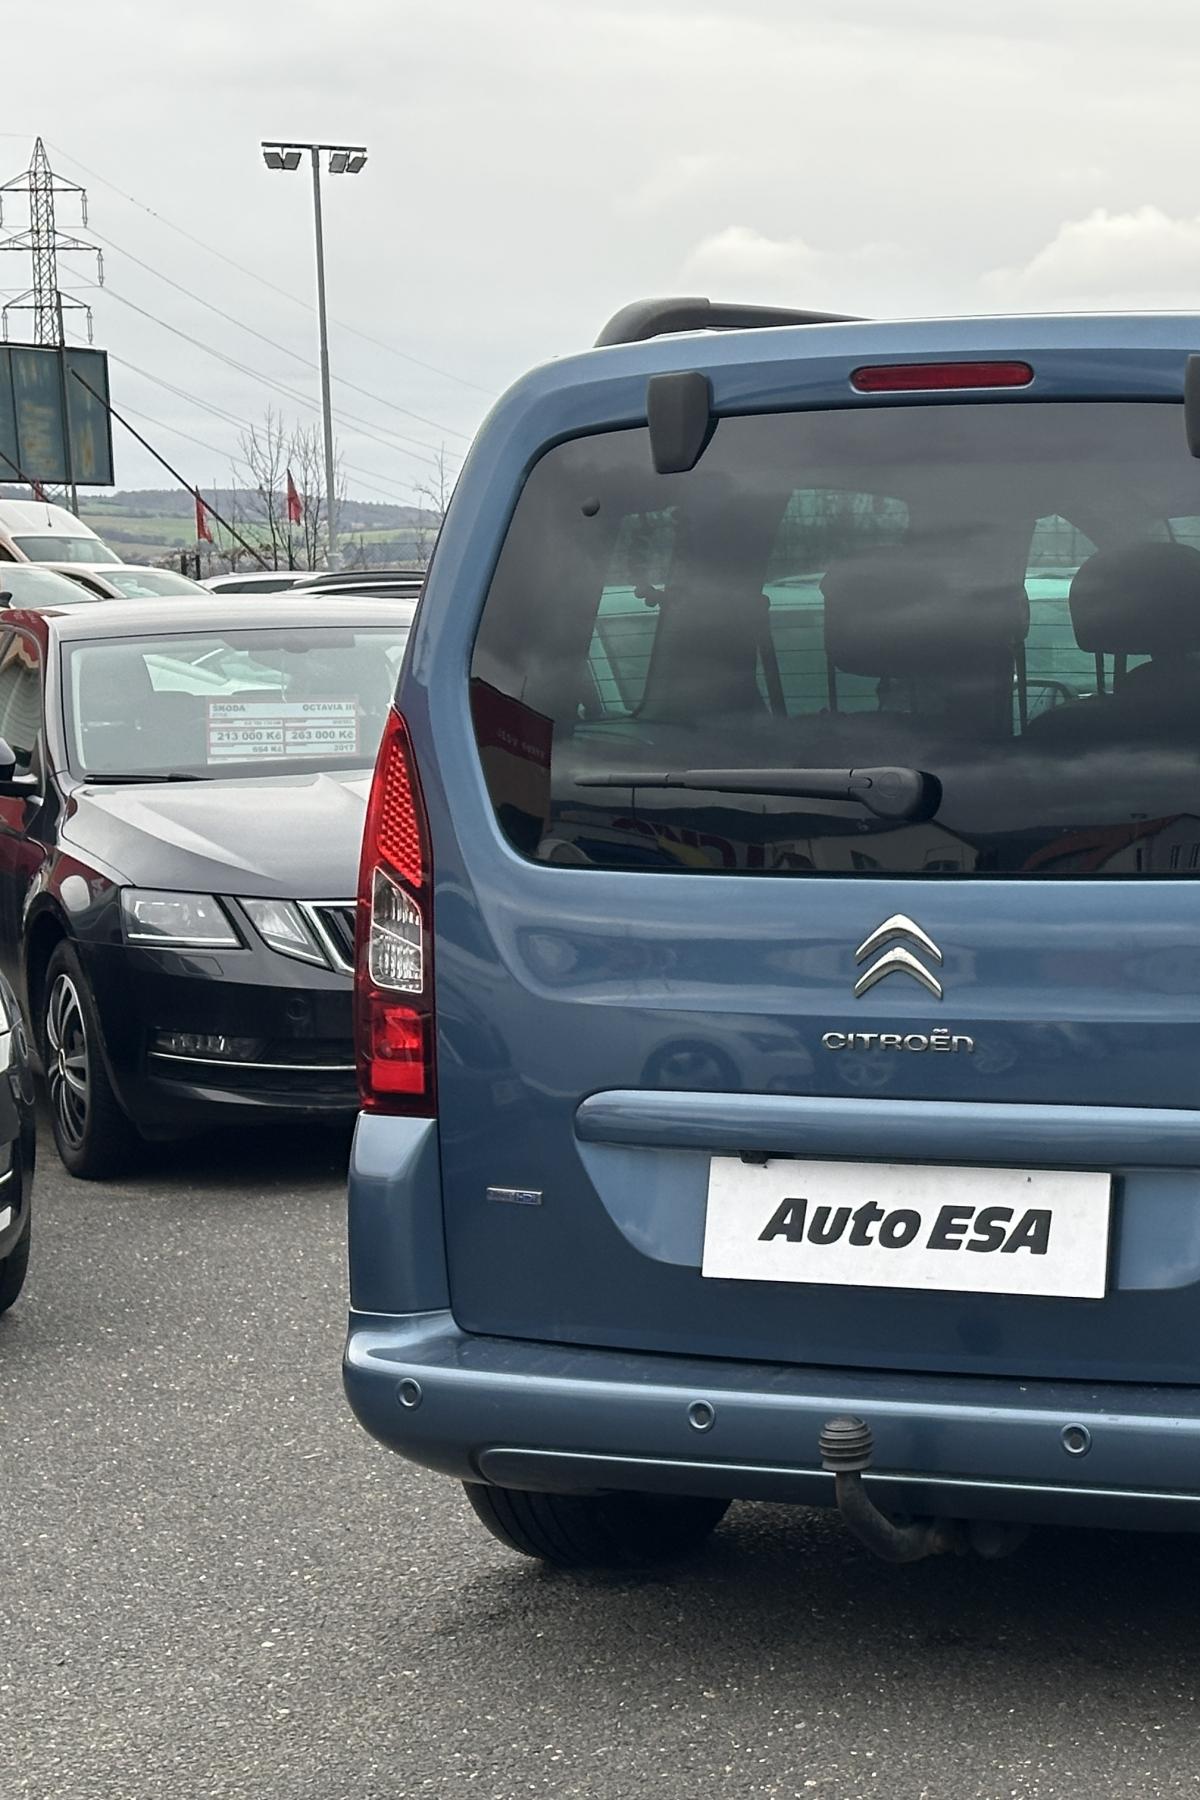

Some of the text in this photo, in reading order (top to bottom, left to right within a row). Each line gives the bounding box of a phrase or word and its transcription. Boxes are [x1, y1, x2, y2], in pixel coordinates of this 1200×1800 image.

[302, 703, 343, 712] OCTAVIA
[217, 731, 282, 741] 213 000 Kč
[315, 730, 336, 740] 000
[338, 730, 354, 739] Kč
[821, 1028, 975, 1052] CITROËN
[757, 1197, 1053, 1255] Auto ESA
